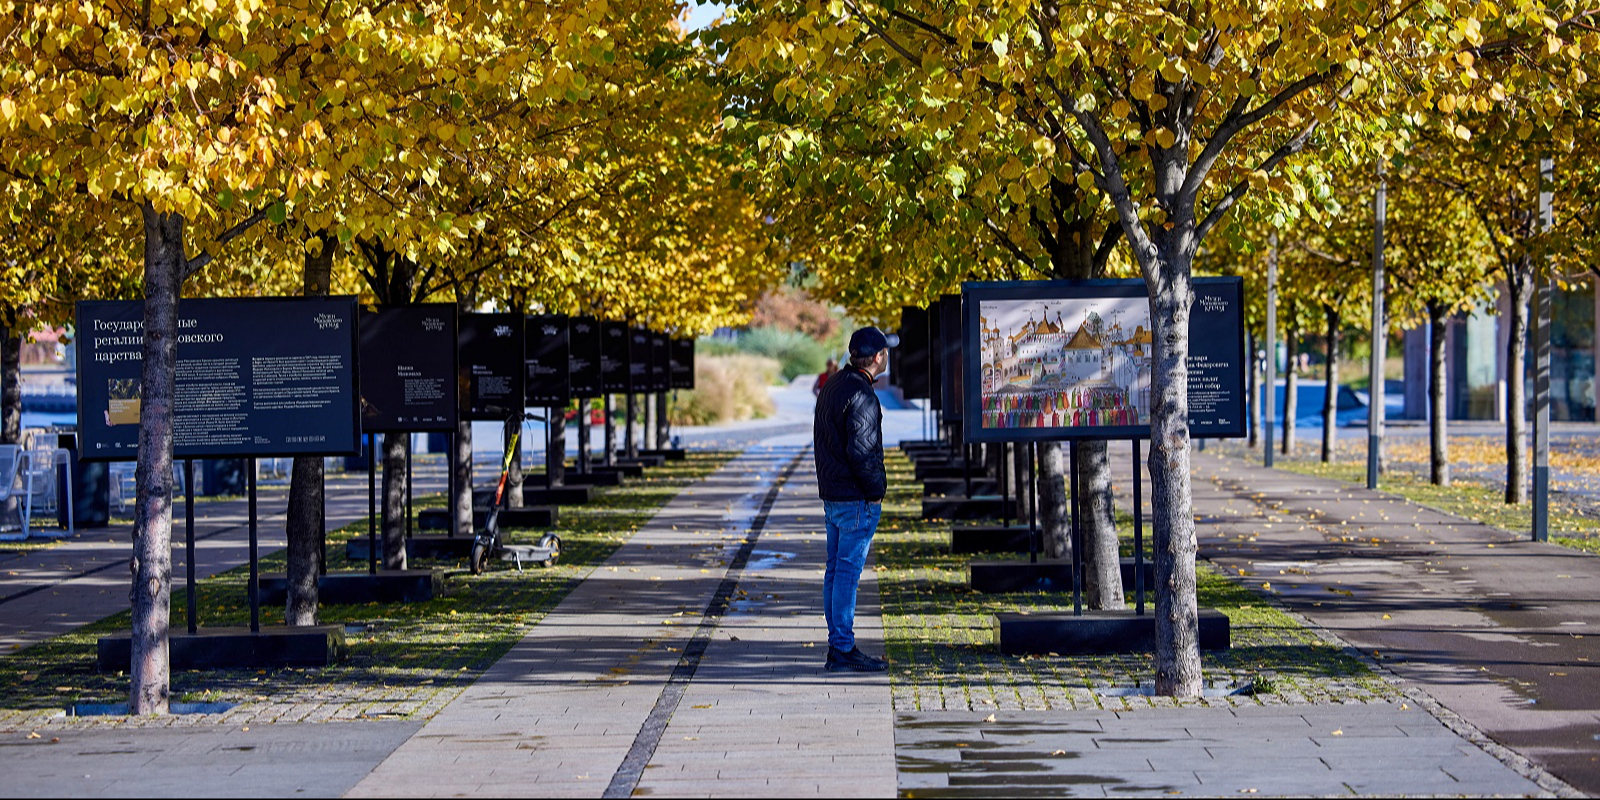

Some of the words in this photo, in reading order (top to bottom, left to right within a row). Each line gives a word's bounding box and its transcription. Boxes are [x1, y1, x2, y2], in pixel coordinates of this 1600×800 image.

[94, 335, 144, 349] регалии
[177, 333, 224, 344] овского
[95, 351, 143, 364] царства
